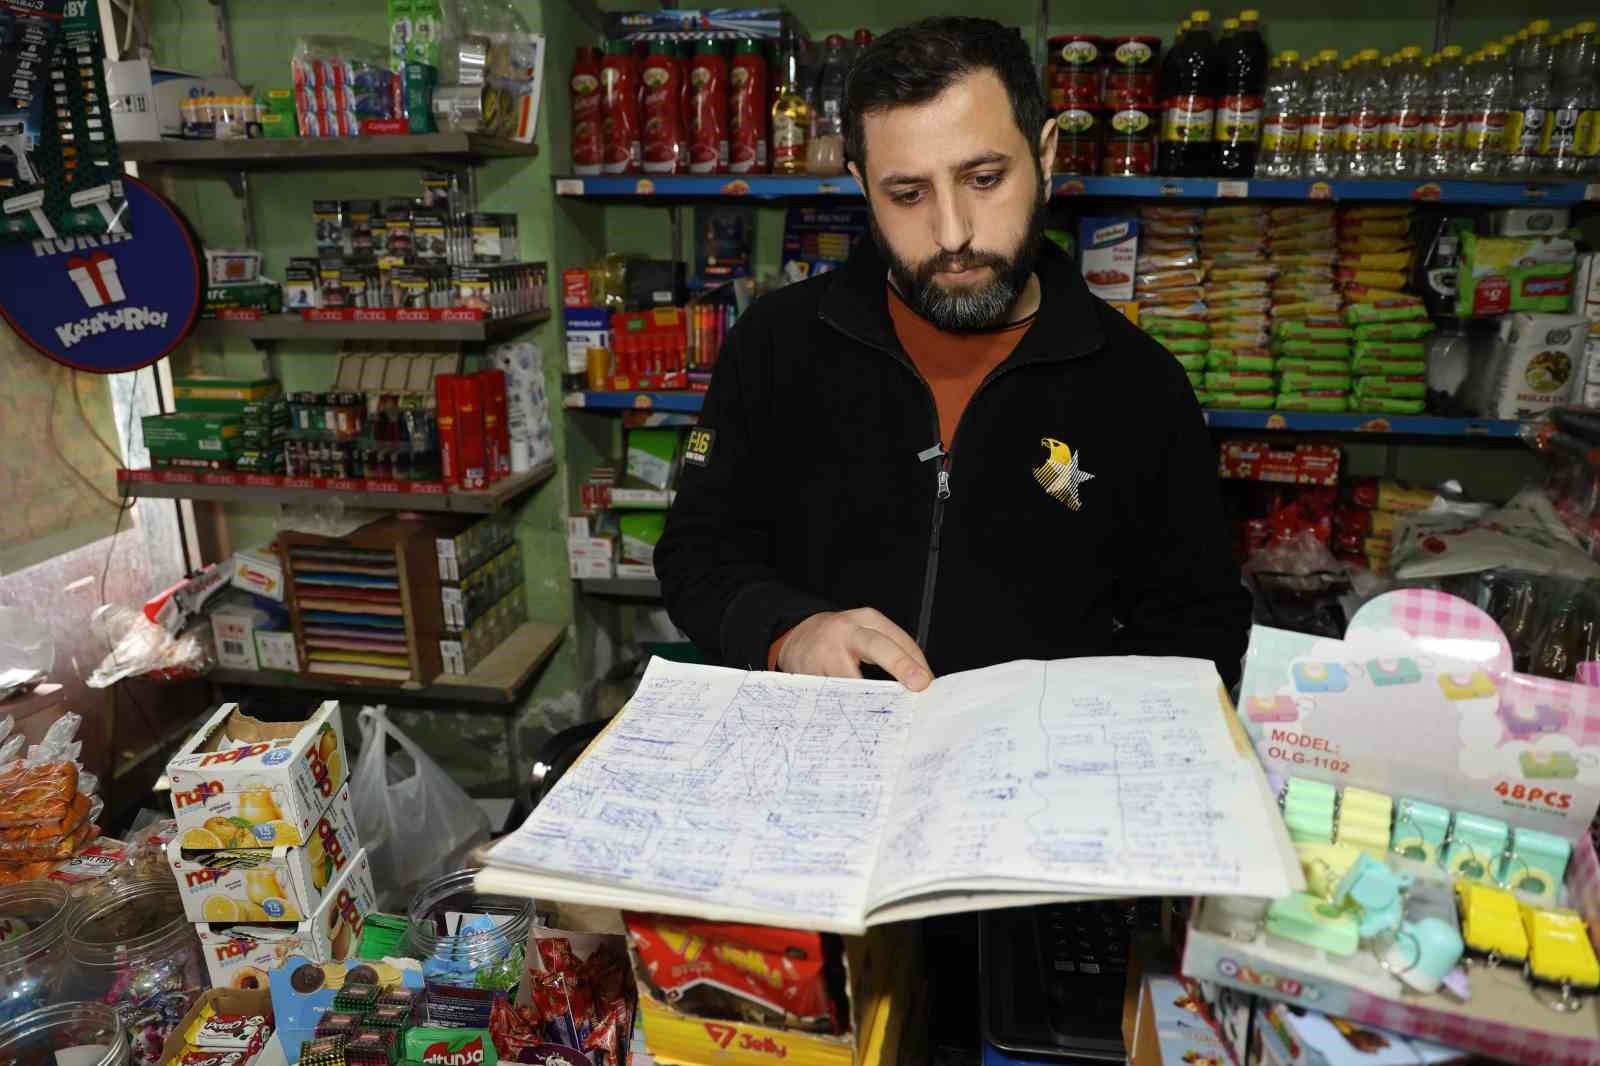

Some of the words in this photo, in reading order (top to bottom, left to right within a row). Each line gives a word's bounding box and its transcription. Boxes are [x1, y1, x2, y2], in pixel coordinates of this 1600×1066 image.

[63, 0, 89, 17] BY
[1271, 729, 1342, 753] MODEL:
[1268, 746, 1350, 773] OLG-1102
[1495, 781, 1572, 809] 48PCS
